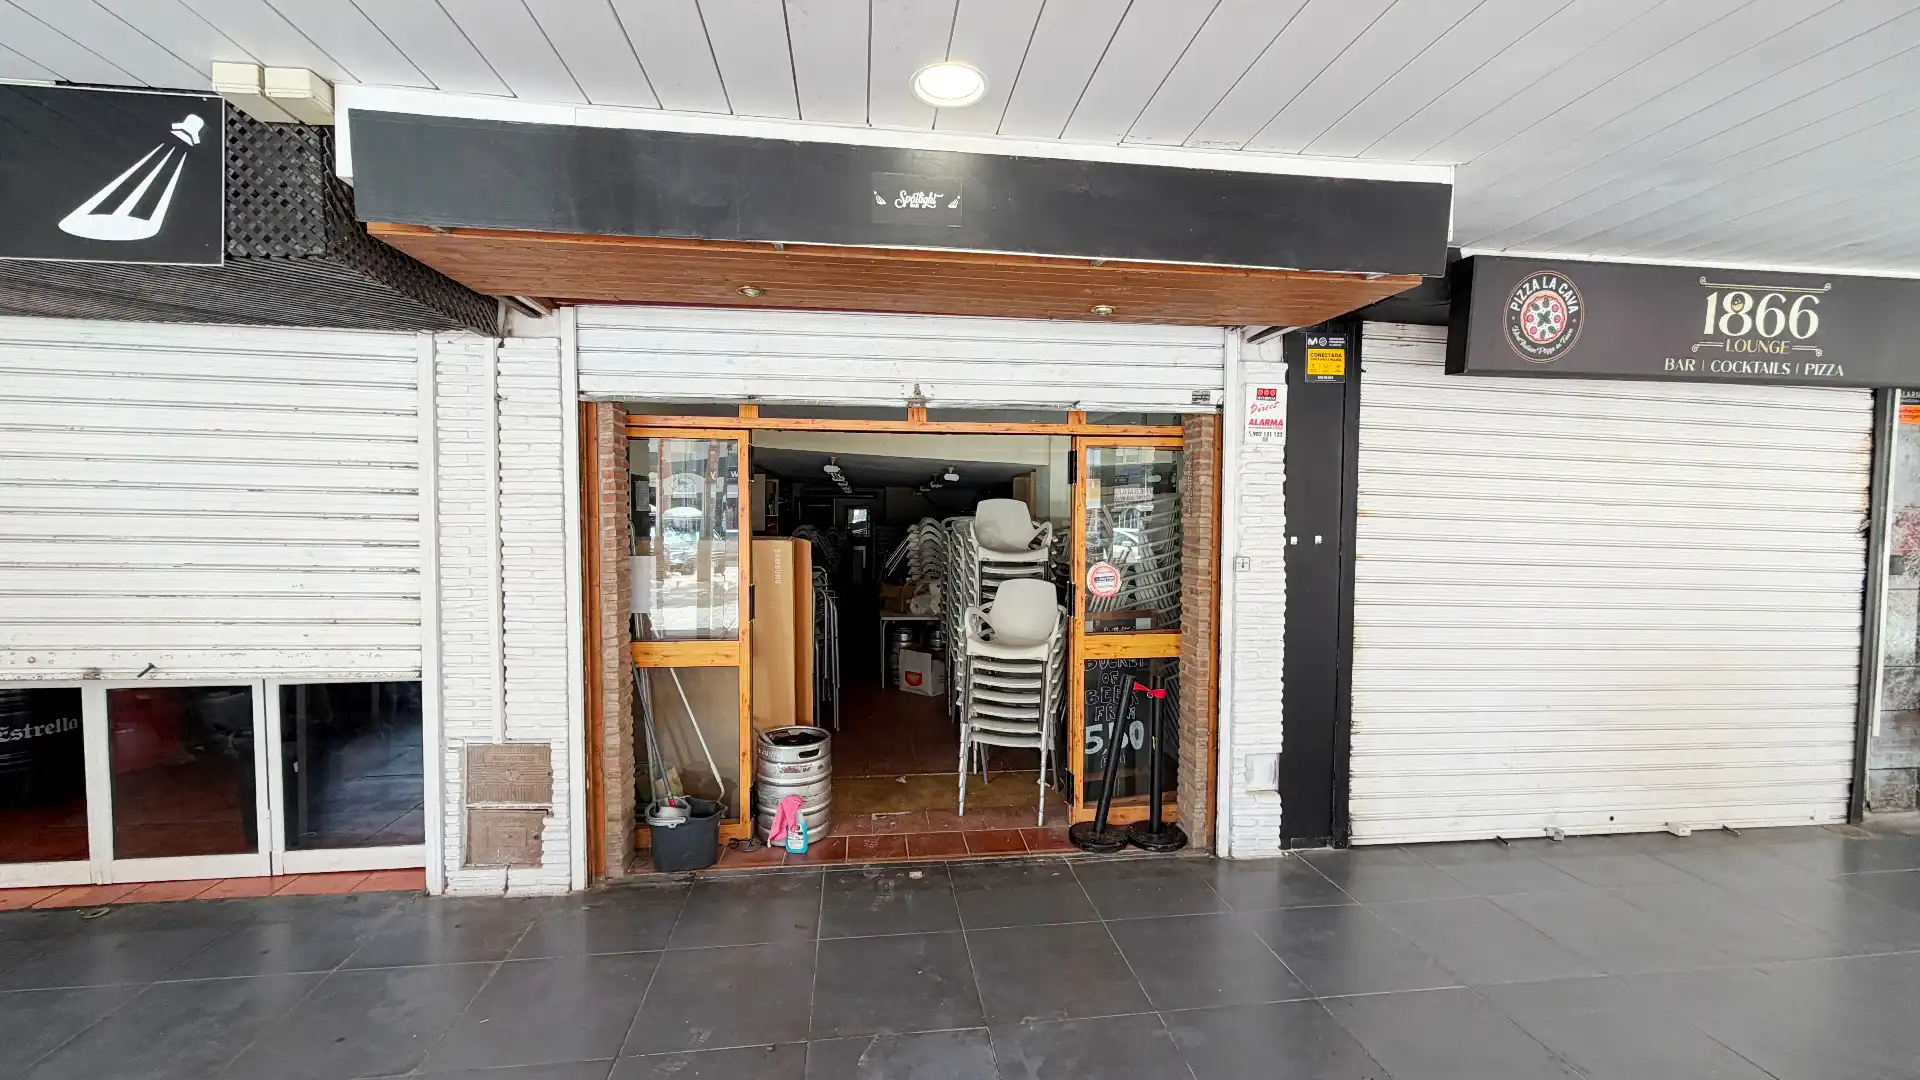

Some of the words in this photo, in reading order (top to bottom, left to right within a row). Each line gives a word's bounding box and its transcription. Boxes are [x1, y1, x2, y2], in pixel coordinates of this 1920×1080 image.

[894, 190, 944, 209] Spotlight
[1510, 279, 1540, 311] PIZZA
[1542, 276, 1557, 289] LA
[1558, 283, 1579, 314] CAVA
[1703, 291, 1820, 340] 1866
[1725, 339, 1790, 355] LOUNGE
[1664, 358, 1695, 372] BAR
[1710, 359, 1791, 375] COCKTAILS
[1804, 363, 1844, 377] PIZZA
[1248, 418, 1284, 427] ALARMA
[1101, 671, 1119, 685] OF
[1094, 704, 1137, 722] FRM
[0, 717, 78, 742] Estrella
